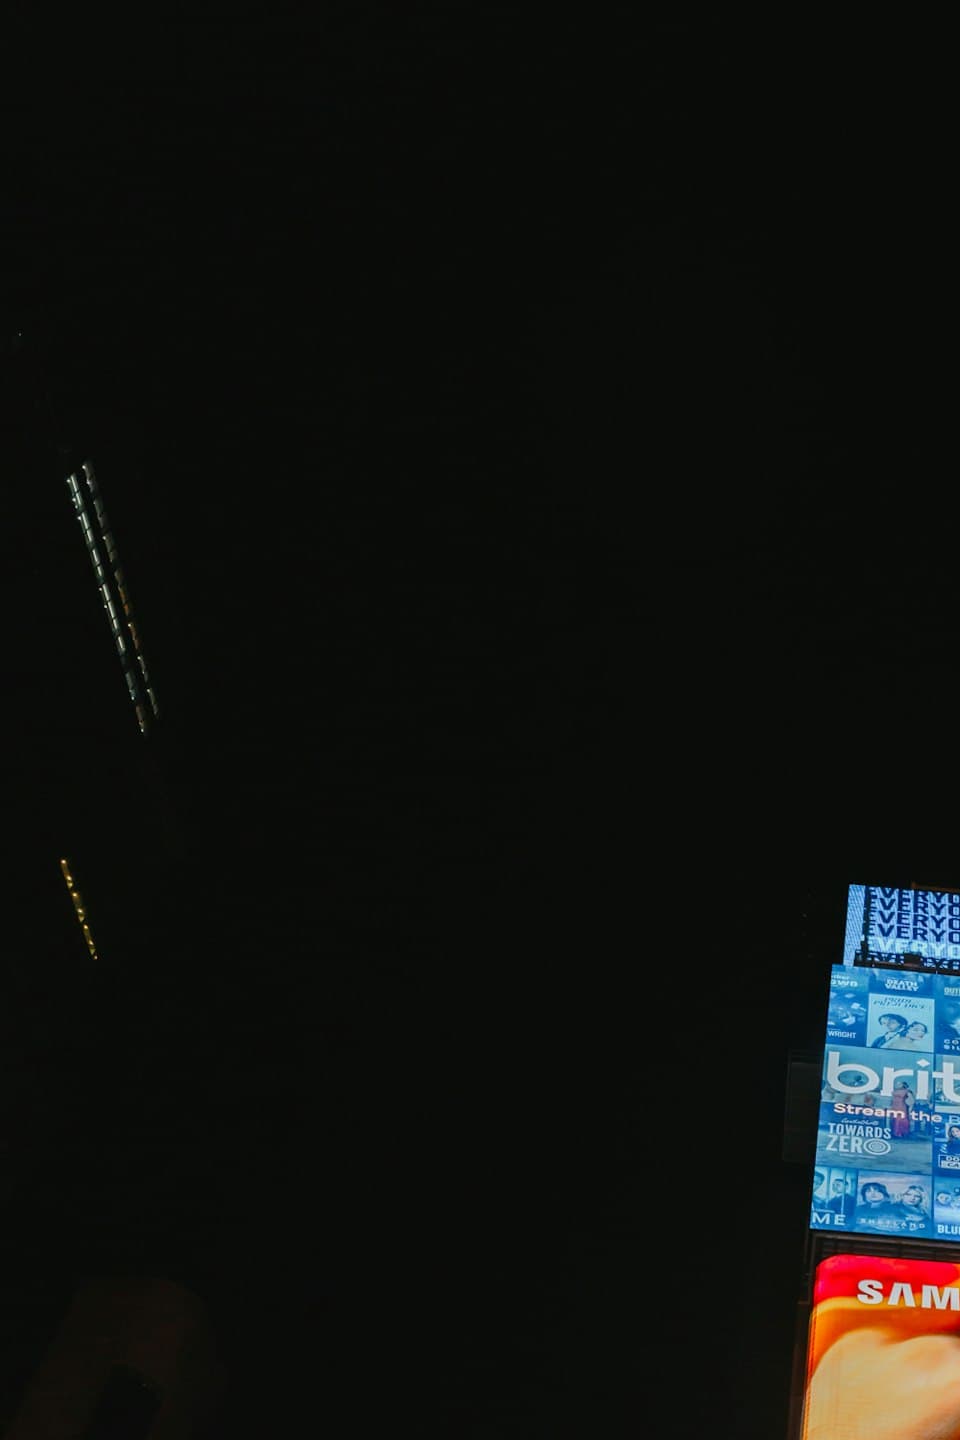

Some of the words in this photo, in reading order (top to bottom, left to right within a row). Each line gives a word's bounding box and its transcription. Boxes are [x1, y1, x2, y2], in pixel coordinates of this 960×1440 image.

[833, 1102, 906, 1119] Stream
[910, 1110, 943, 1123] the
[828, 1122, 892, 1140] TOWARDS
